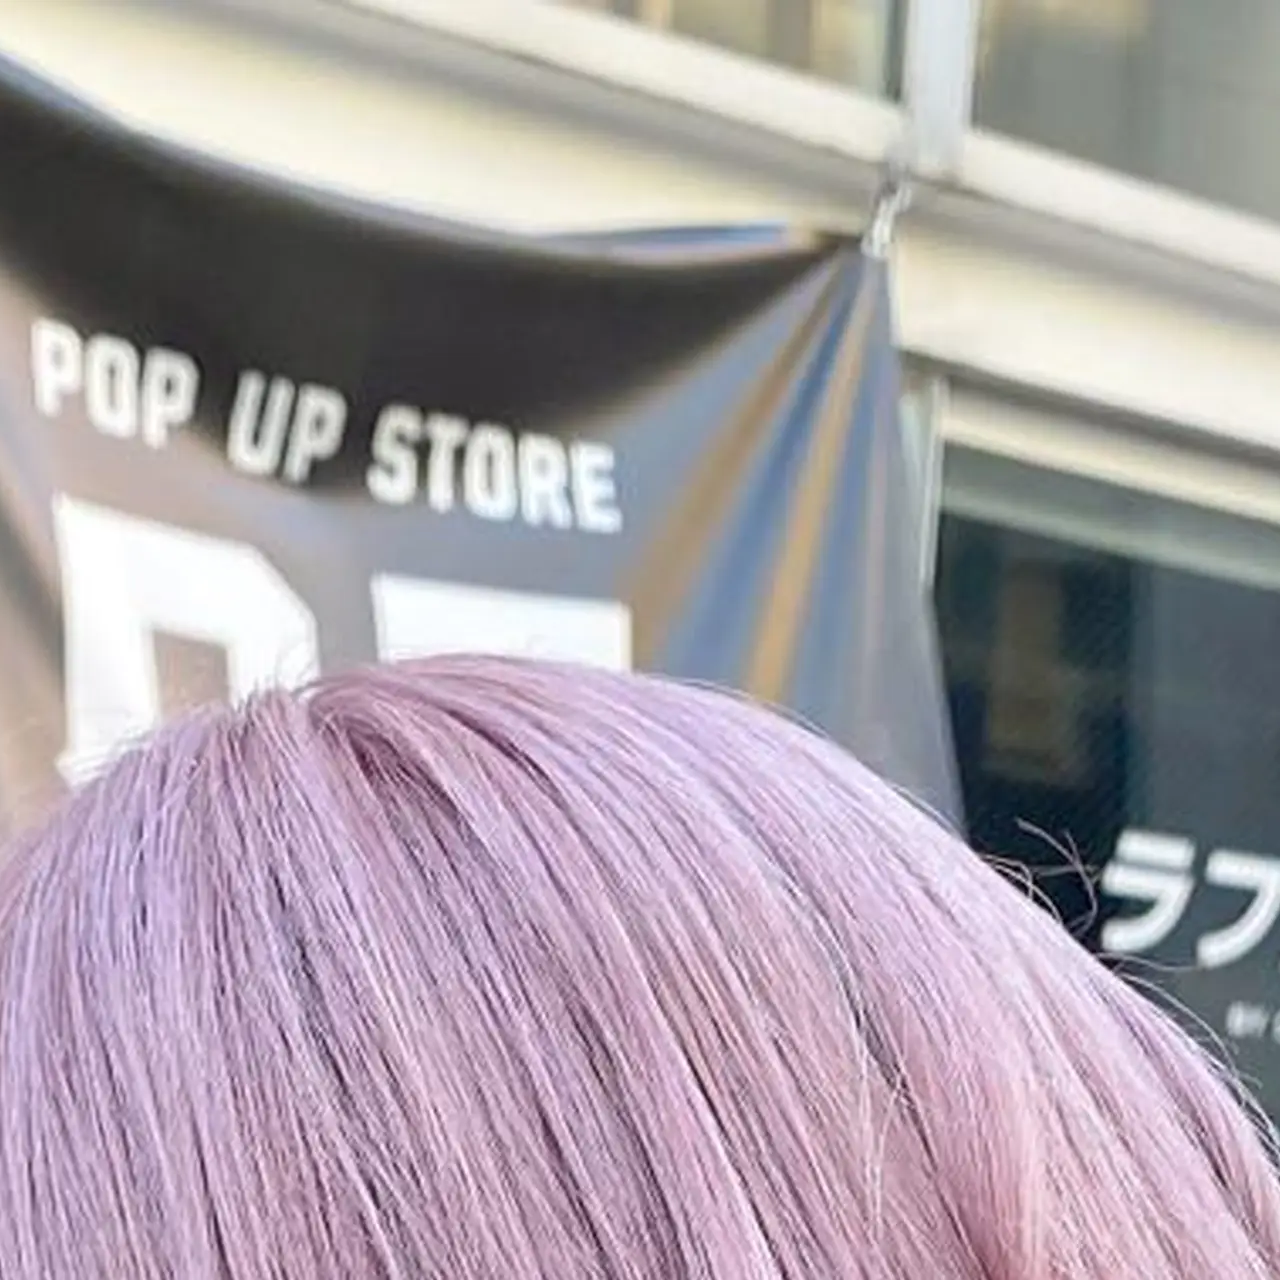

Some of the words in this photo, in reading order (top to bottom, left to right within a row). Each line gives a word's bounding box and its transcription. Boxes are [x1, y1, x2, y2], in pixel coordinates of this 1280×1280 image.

[30, 318, 200, 447] POP
[227, 370, 348, 483] UP
[368, 406, 623, 533] STORE
